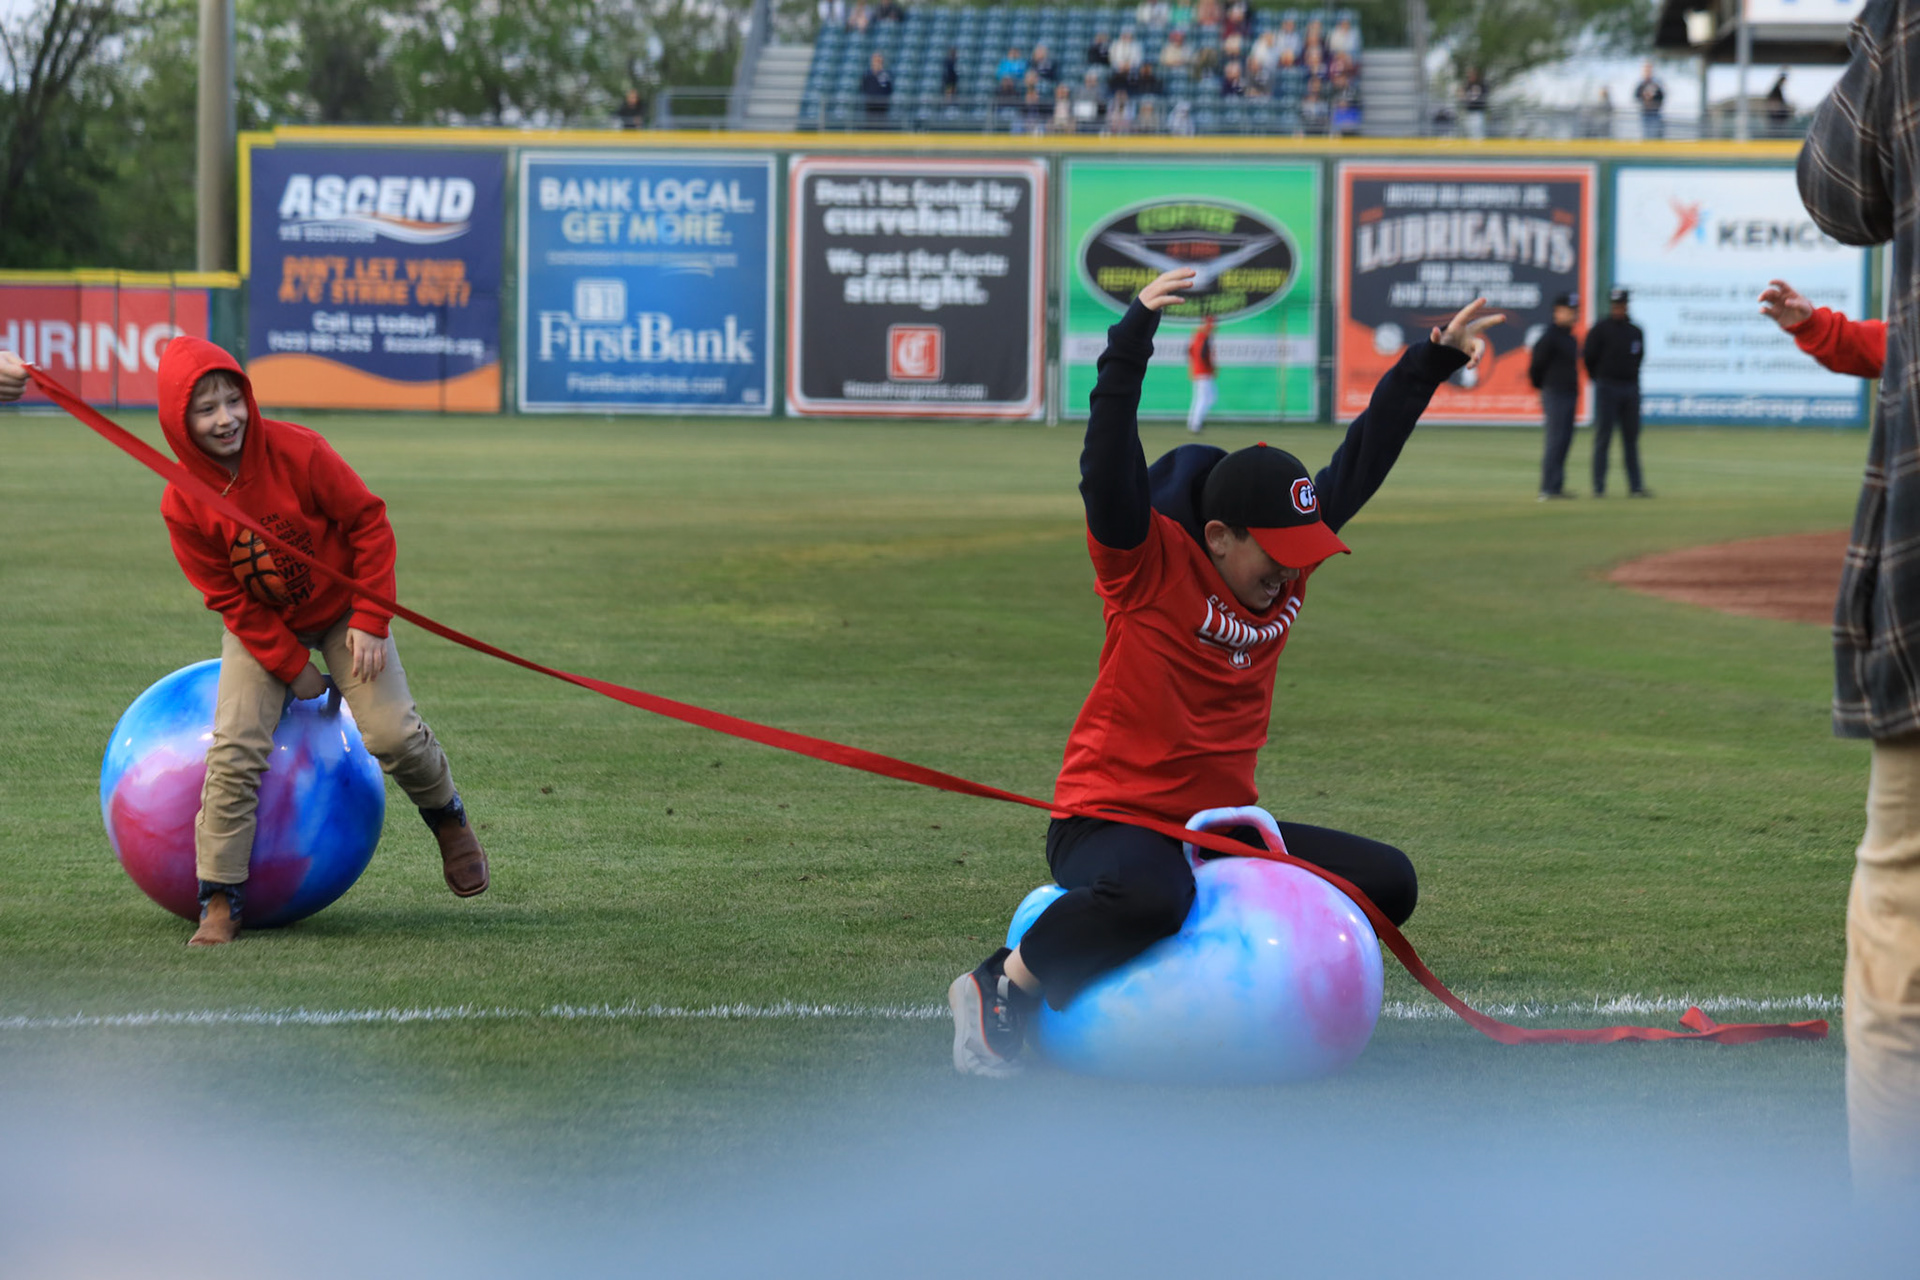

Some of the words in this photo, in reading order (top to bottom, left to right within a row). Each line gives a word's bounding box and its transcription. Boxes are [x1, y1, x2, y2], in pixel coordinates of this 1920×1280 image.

[279, 174, 475, 222] ASCEND
[540, 177, 632, 211] BANK
[640, 179, 755, 213] LOCAL.
[815, 179, 876, 205] Don't
[880, 179, 908, 205] be
[913, 179, 983, 206] fooled
[988, 180, 1021, 212] by
[562, 211, 624, 244] GET
[629, 213, 733, 245] MORE.
[823, 203, 1012, 236] curveballs.
[1357, 211, 1574, 274] LUBRICANTS
[283, 256, 348, 283] DON'T
[355, 257, 397, 283] LET
[405, 259, 466, 284] YOUR
[827, 248, 863, 274] We
[866, 252, 903, 278] get
[908, 249, 945, 275] the
[950, 249, 1009, 276] facts
[331, 280, 409, 305] STRIKE
[844, 274, 989, 311] straight.
[312, 310, 350, 333] Call
[352, 315, 374, 334] us
[377, 313, 436, 338] today!
[538, 310, 755, 363] FirstBank
